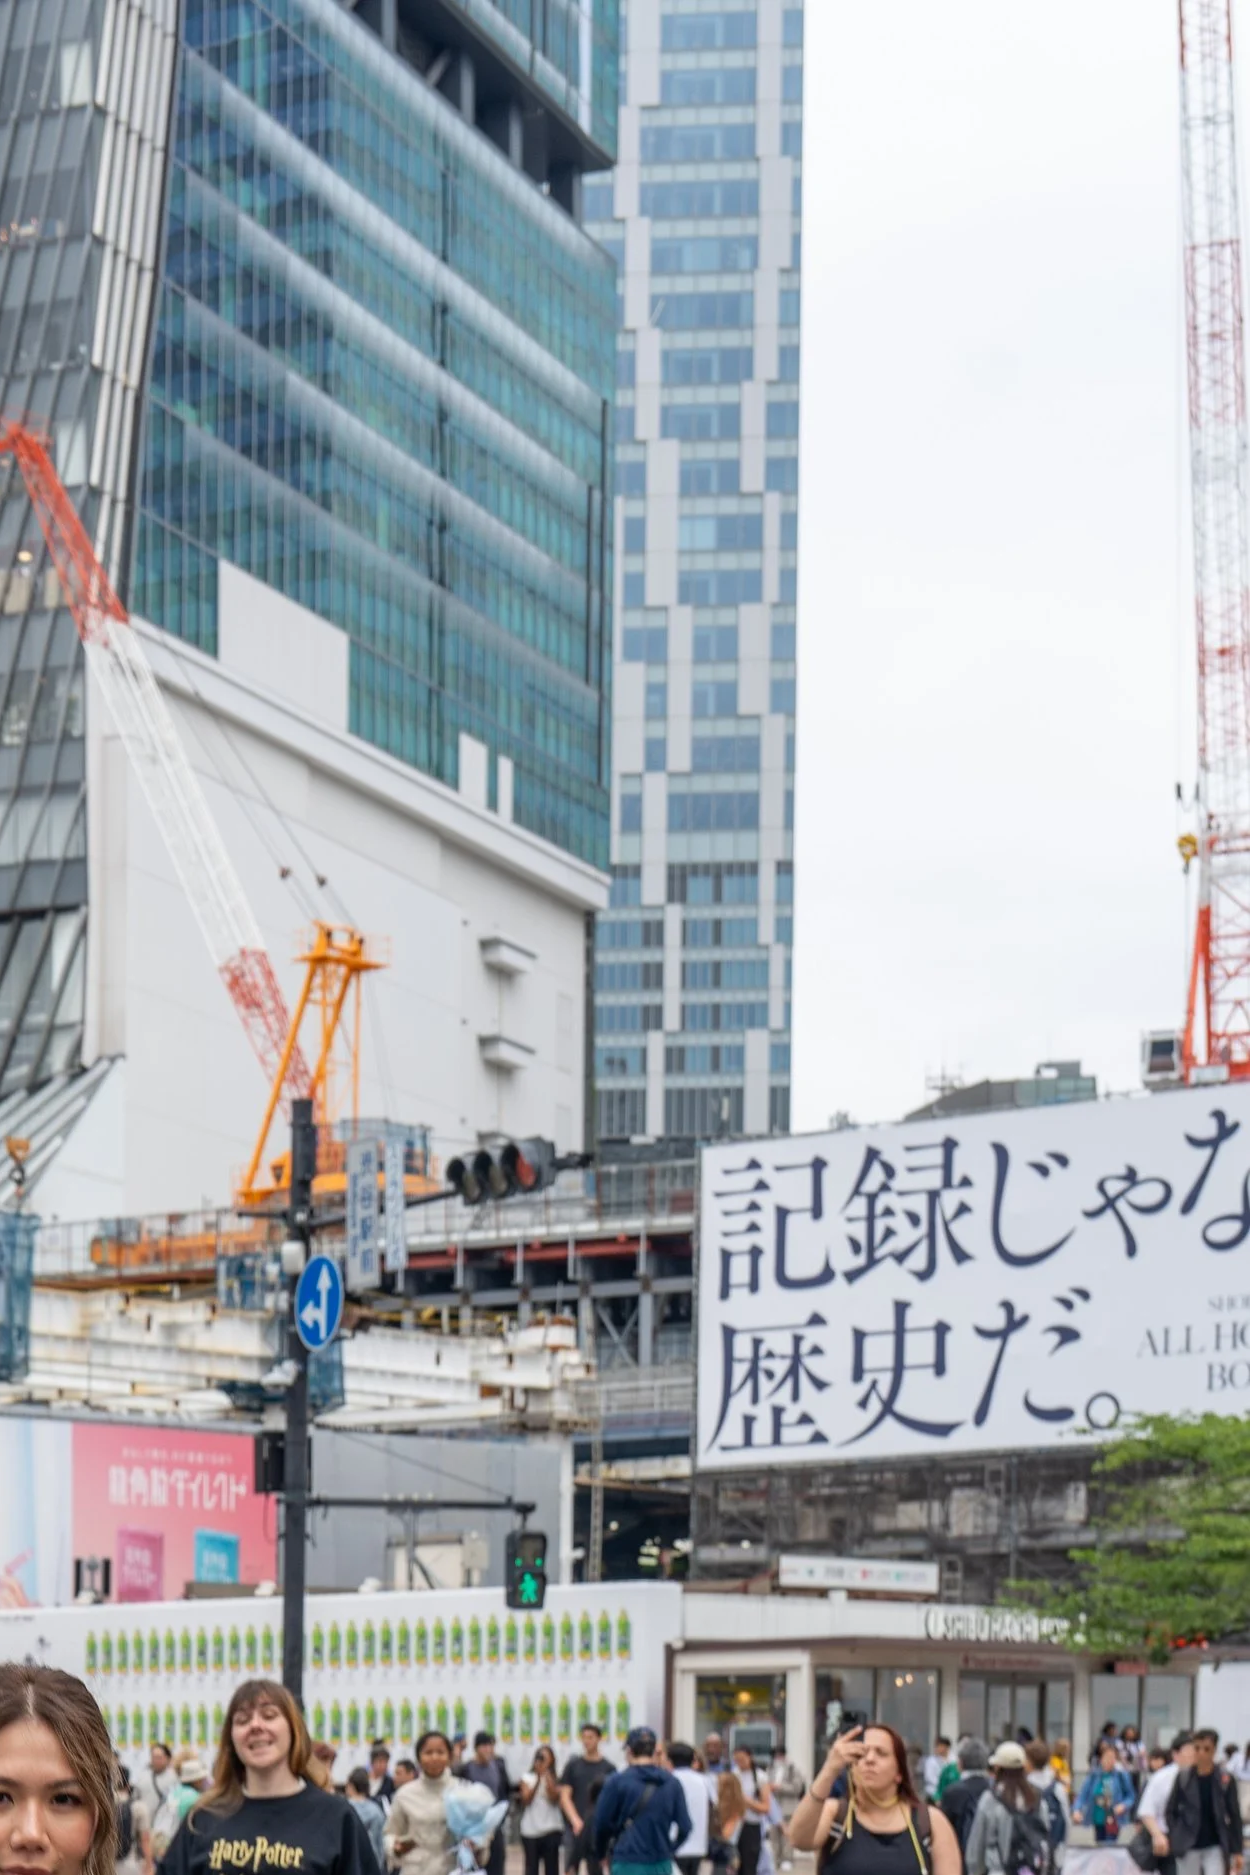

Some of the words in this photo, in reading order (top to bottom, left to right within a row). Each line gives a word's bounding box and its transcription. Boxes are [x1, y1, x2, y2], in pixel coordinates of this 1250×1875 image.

[1136, 1325, 1206, 1358] ALL
[706, 1286, 1122, 1453] 歴史だ。
[209, 1838, 254, 1869] Harry
[253, 1836, 304, 1873] Potter
